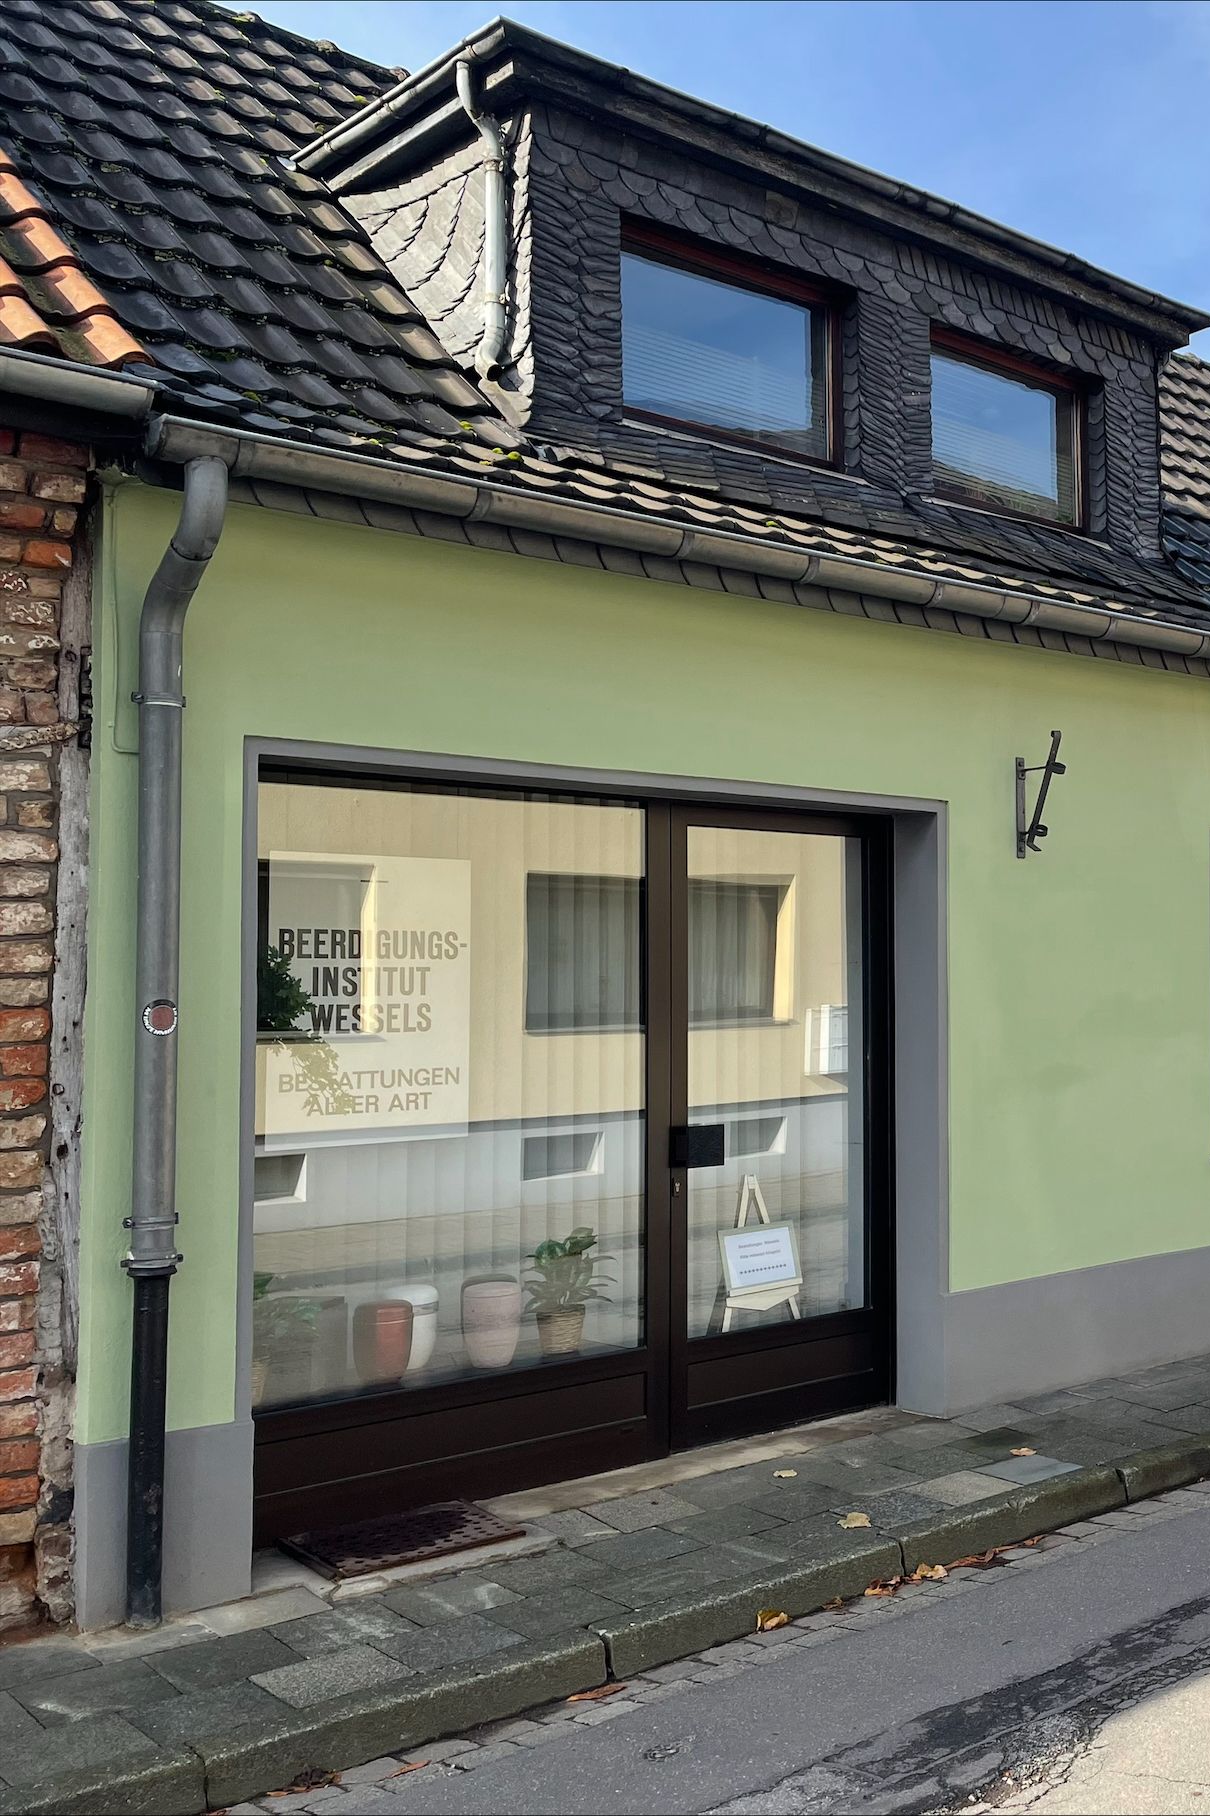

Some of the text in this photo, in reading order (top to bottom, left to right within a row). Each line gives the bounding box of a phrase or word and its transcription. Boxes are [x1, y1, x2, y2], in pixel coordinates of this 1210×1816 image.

[279, 928, 467, 960] BEERDIGUNGS-
[312, 966, 430, 997] INSTITUT
[310, 1003, 431, 1034] WESSELS
[388, 1092, 432, 1112] ART
